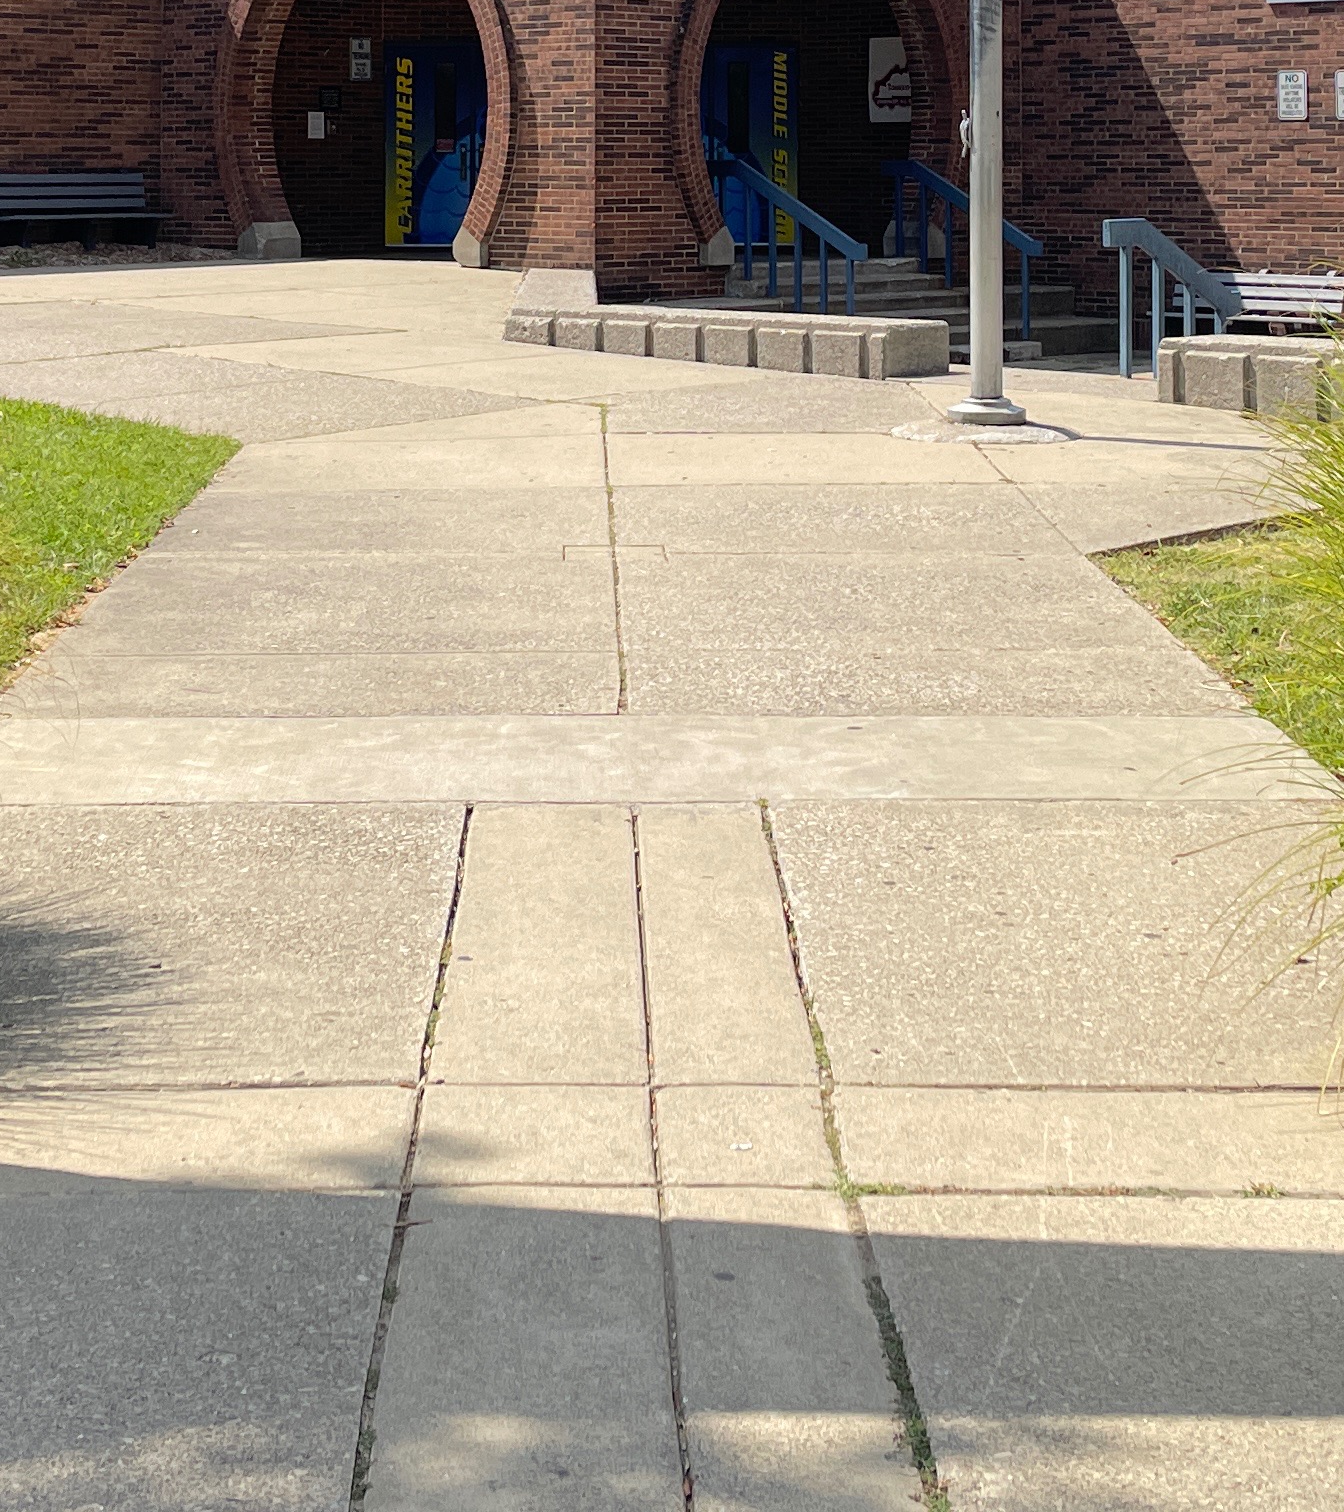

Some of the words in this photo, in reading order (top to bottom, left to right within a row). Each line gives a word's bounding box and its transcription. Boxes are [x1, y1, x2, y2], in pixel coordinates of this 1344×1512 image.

[773, 50, 789, 139] MIDDLE
[1285, 74, 1299, 83] NO
[395, 57, 415, 234] CARRITHERS
